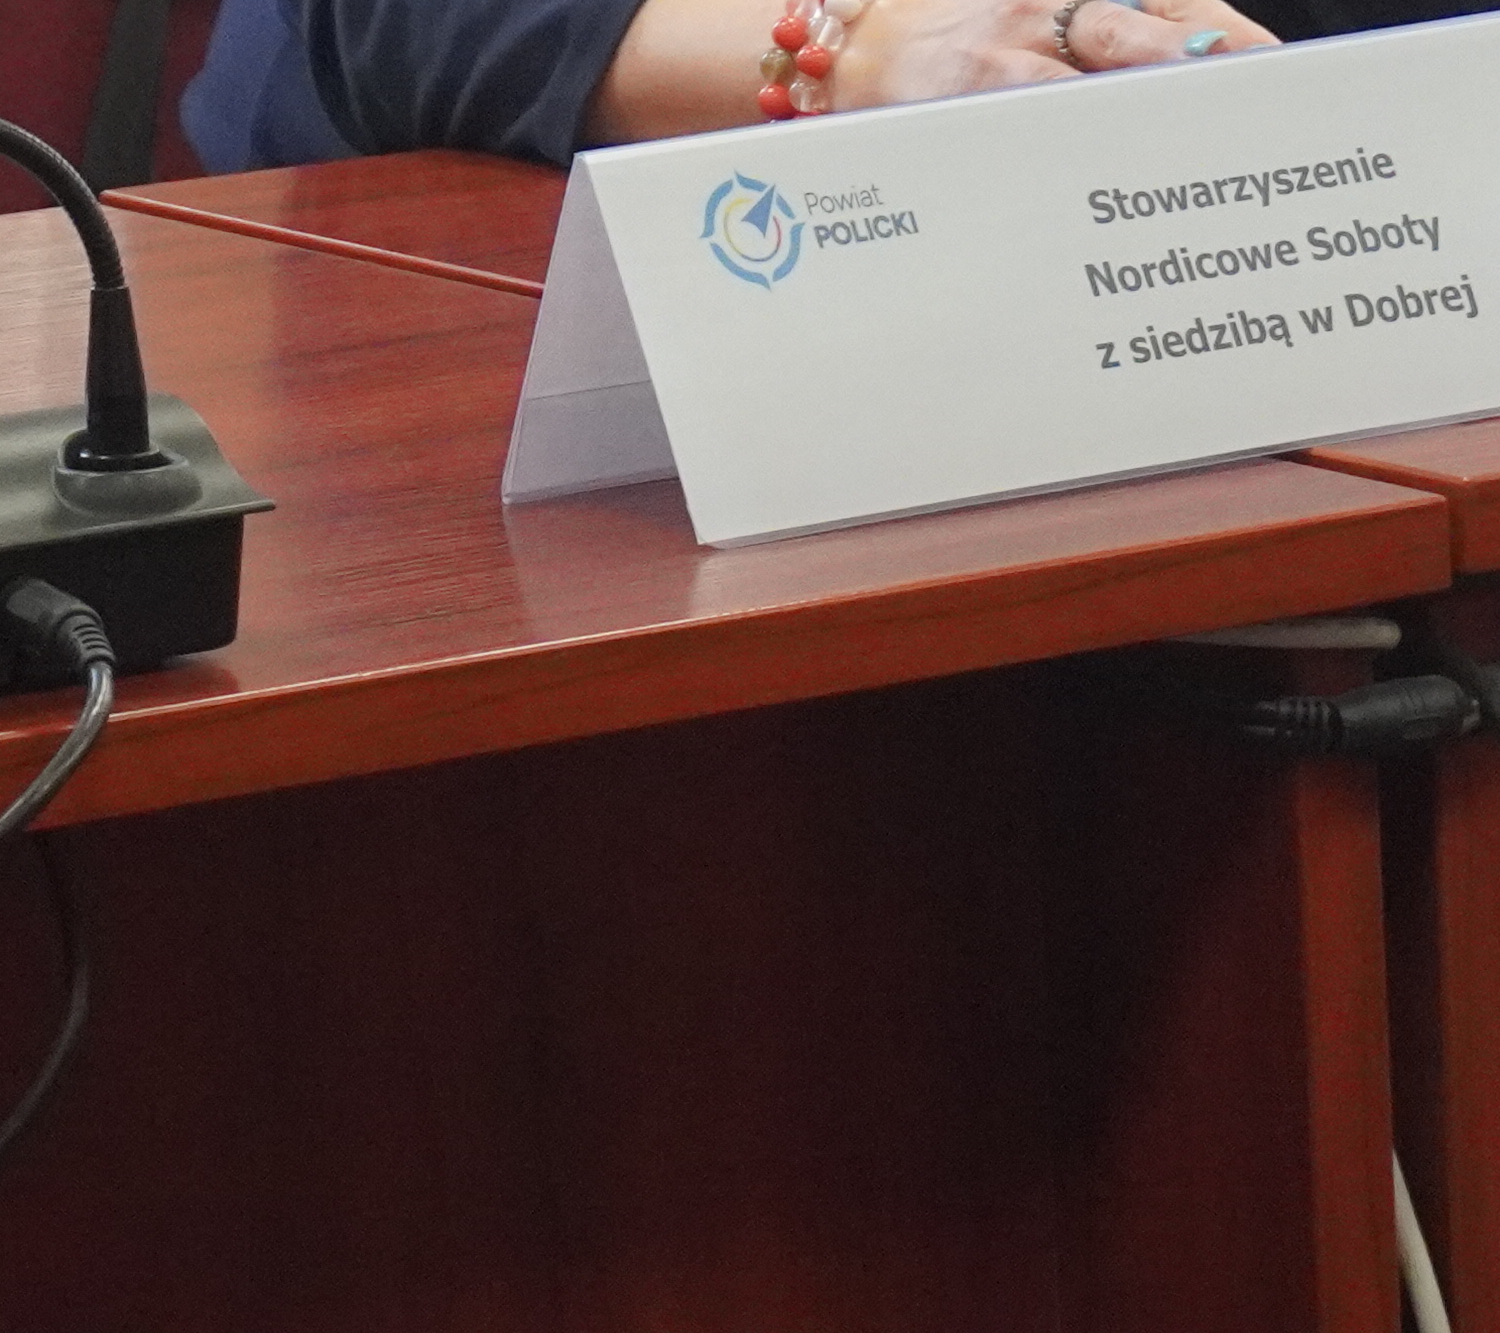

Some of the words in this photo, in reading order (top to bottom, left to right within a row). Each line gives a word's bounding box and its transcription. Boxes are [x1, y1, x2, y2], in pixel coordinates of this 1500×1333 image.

[803, 184, 885, 215] Powiat
[1087, 146, 1397, 224] Stowarzyszenie
[813, 210, 919, 249] POLICKI
[1084, 246, 1300, 298] Nordicowe
[1305, 213, 1440, 262] Soboty
[1095, 340, 1121, 370] z
[1128, 309, 1294, 365] siedzibą
[1298, 304, 1334, 335] w
[1343, 274, 1479, 329] Dobrej
